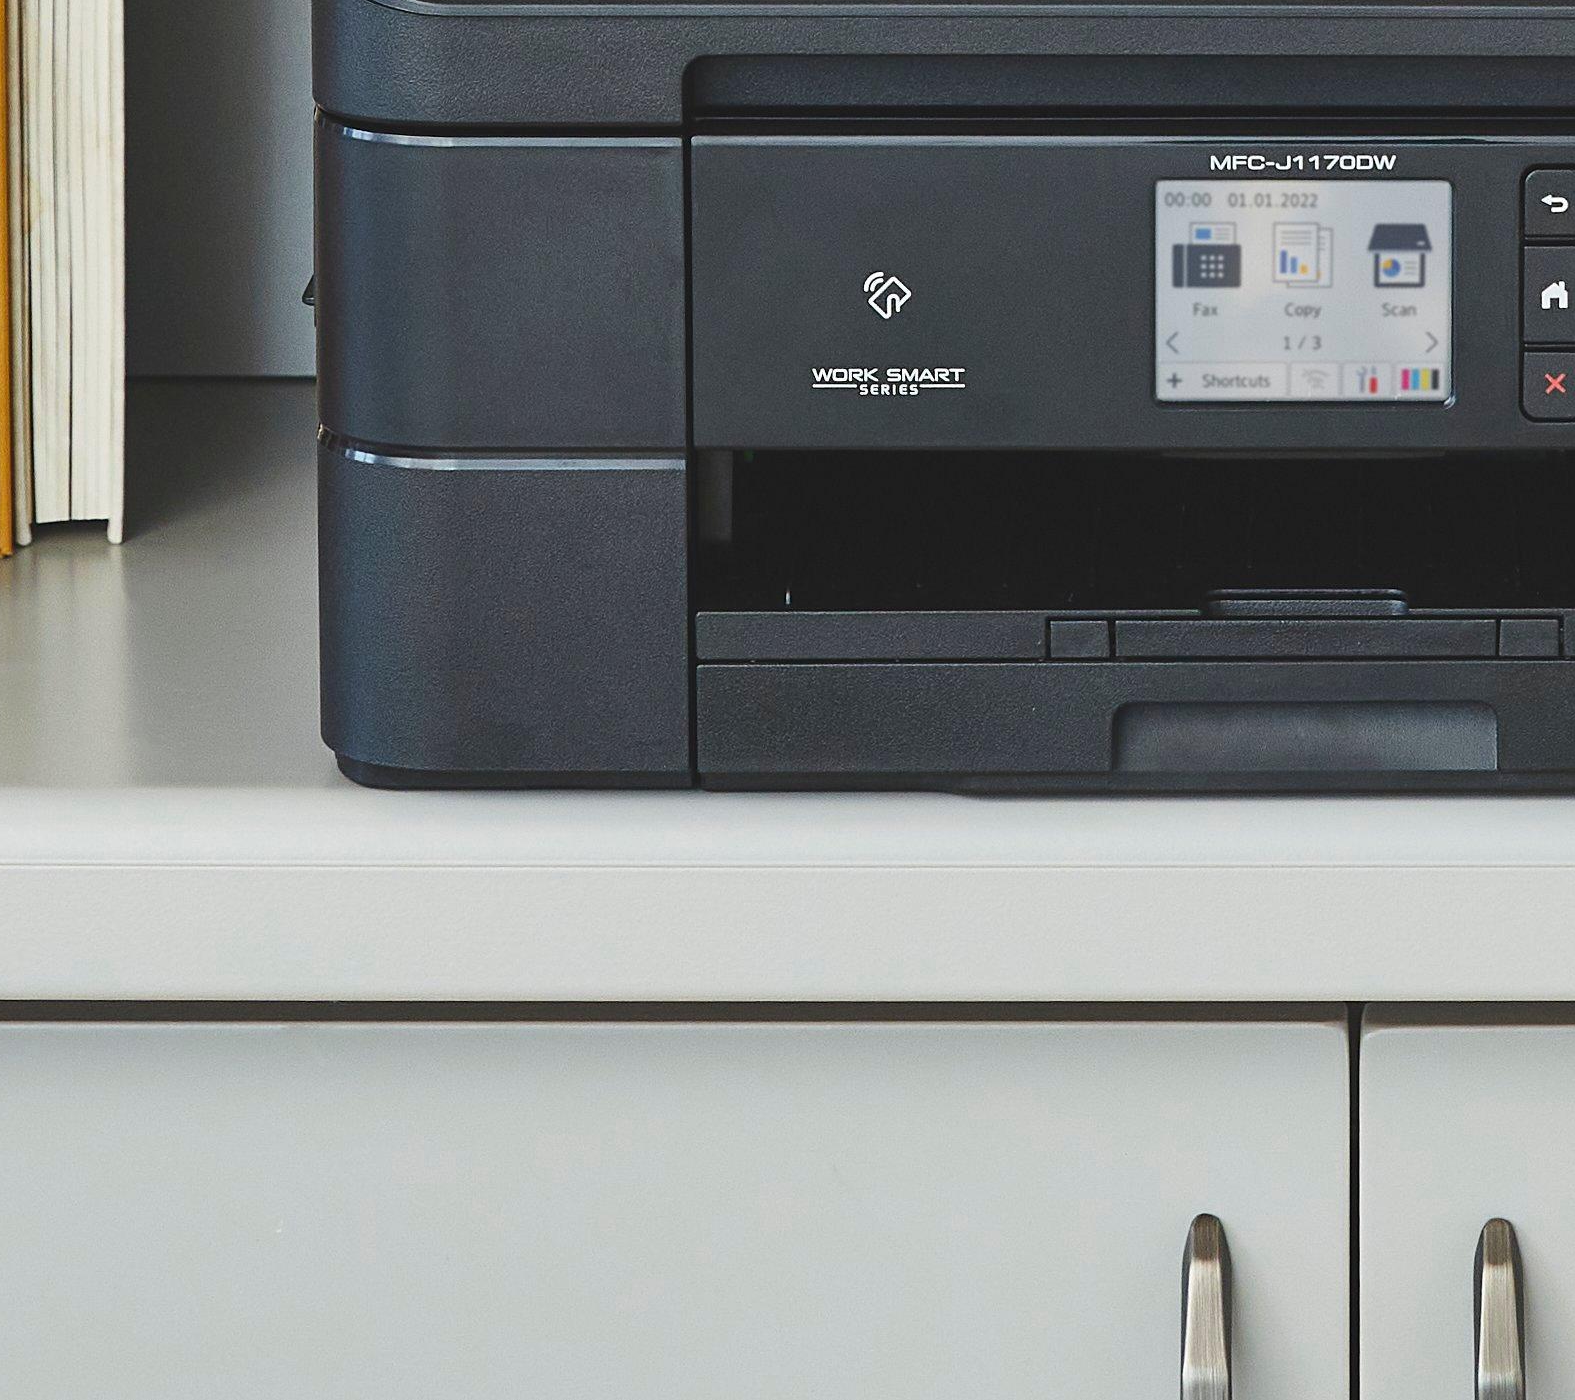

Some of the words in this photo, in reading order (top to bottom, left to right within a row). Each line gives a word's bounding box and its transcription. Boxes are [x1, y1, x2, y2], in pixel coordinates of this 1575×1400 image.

[1210, 154, 1397, 171] MFC-J1170DW
[1164, 191, 1213, 209] 00:00
[1227, 192, 1319, 209] 01.01.2022
[1192, 301, 1219, 317] Fax
[1284, 302, 1322, 319] Copy
[1381, 301, 1418, 317] Scan
[811, 367, 879, 382] WORK
[886, 367, 965, 382] SMART
[1201, 373, 1271, 389] Shortcuts
[859, 383, 919, 396] SERIES
